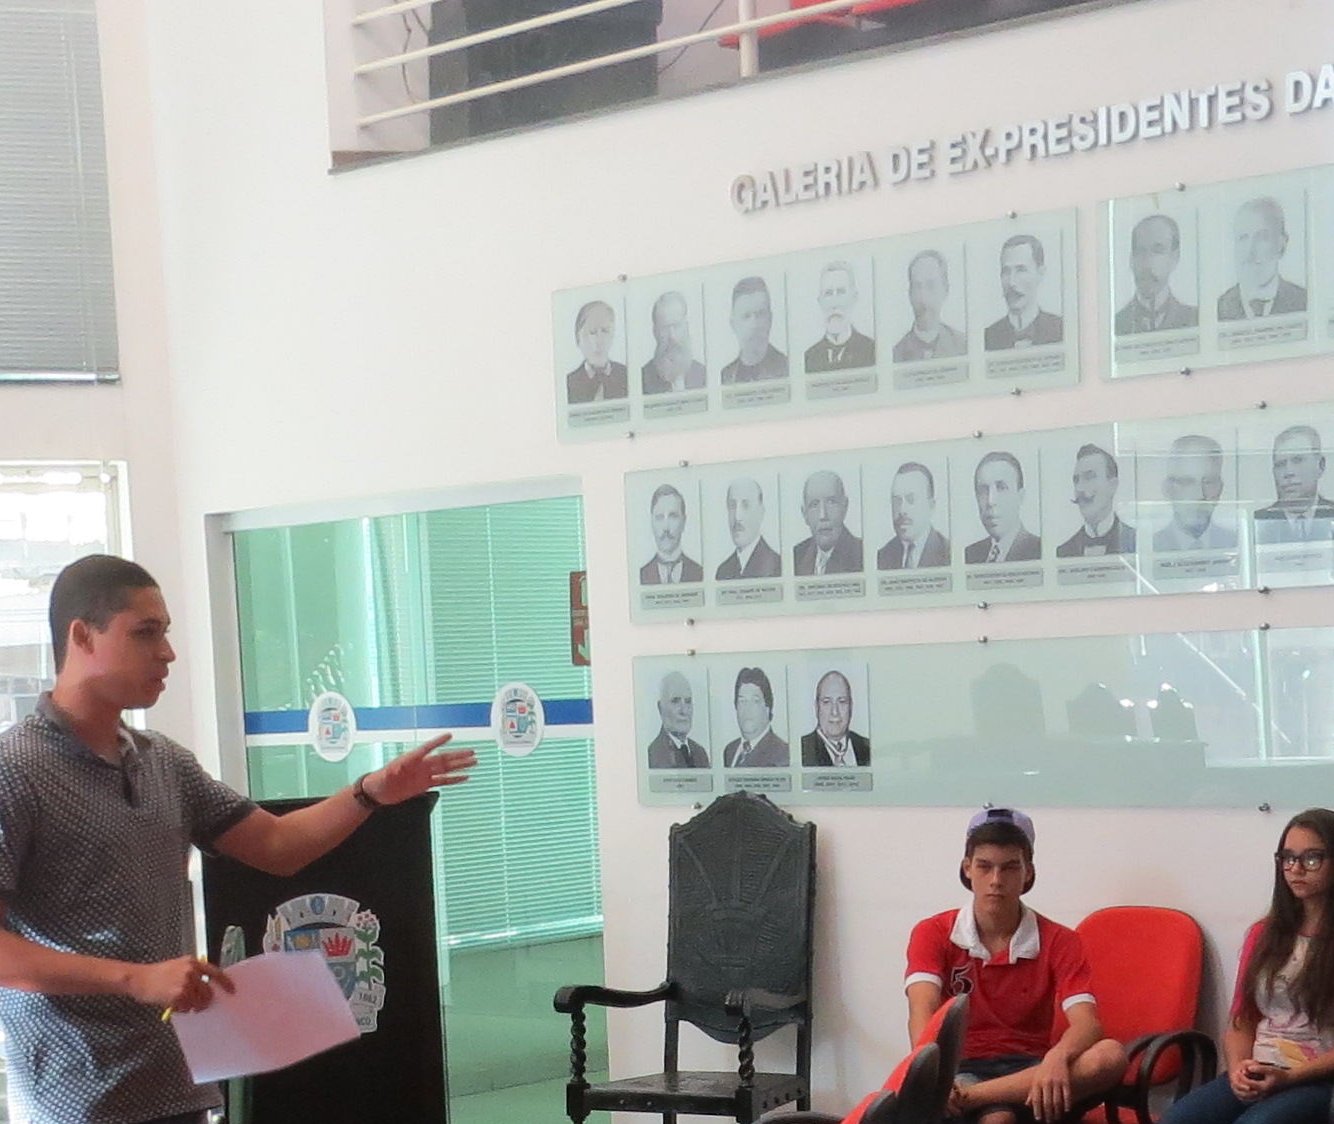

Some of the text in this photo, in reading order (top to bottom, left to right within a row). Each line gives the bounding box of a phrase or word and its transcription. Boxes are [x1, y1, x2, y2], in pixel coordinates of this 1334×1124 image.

[729, 150, 880, 213] GALERIA
[887, 140, 935, 186] DE
[946, 78, 1272, 175] EX-PRESIDENTES
[950, 961, 974, 997] 5
